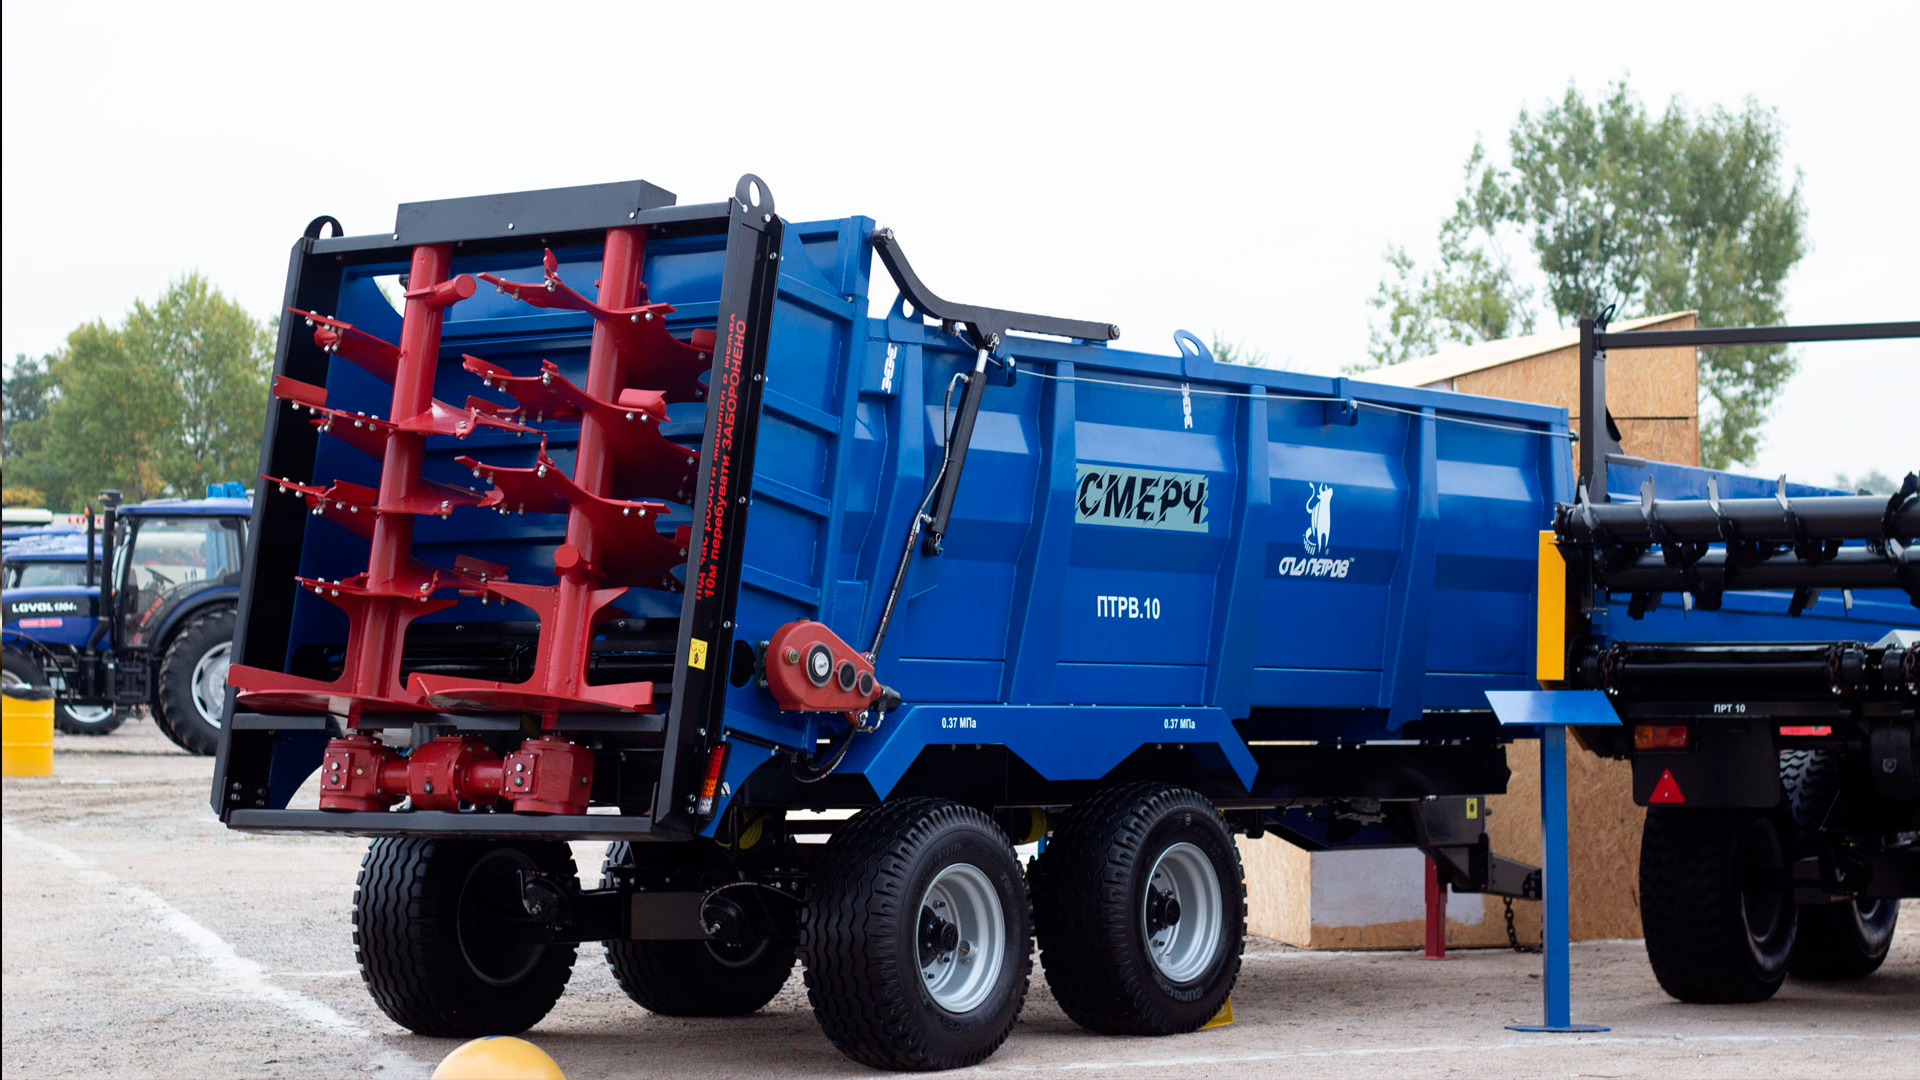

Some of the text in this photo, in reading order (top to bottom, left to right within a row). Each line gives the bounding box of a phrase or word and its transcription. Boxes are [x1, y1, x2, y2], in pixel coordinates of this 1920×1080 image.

[704, 320, 747, 598] 10м перебувати ЗАБОРОНЕНО
[1078, 471, 1206, 525] СМЕРЧ
[11, 602, 54, 614] LOVOL
[1097, 595, 1161, 620] ПТРВ.10
[1713, 703, 1746, 714] ПРТ 10
[941, 716, 977, 729] 0.37 МПа
[1163, 718, 1196, 729] 0.37 МПа
